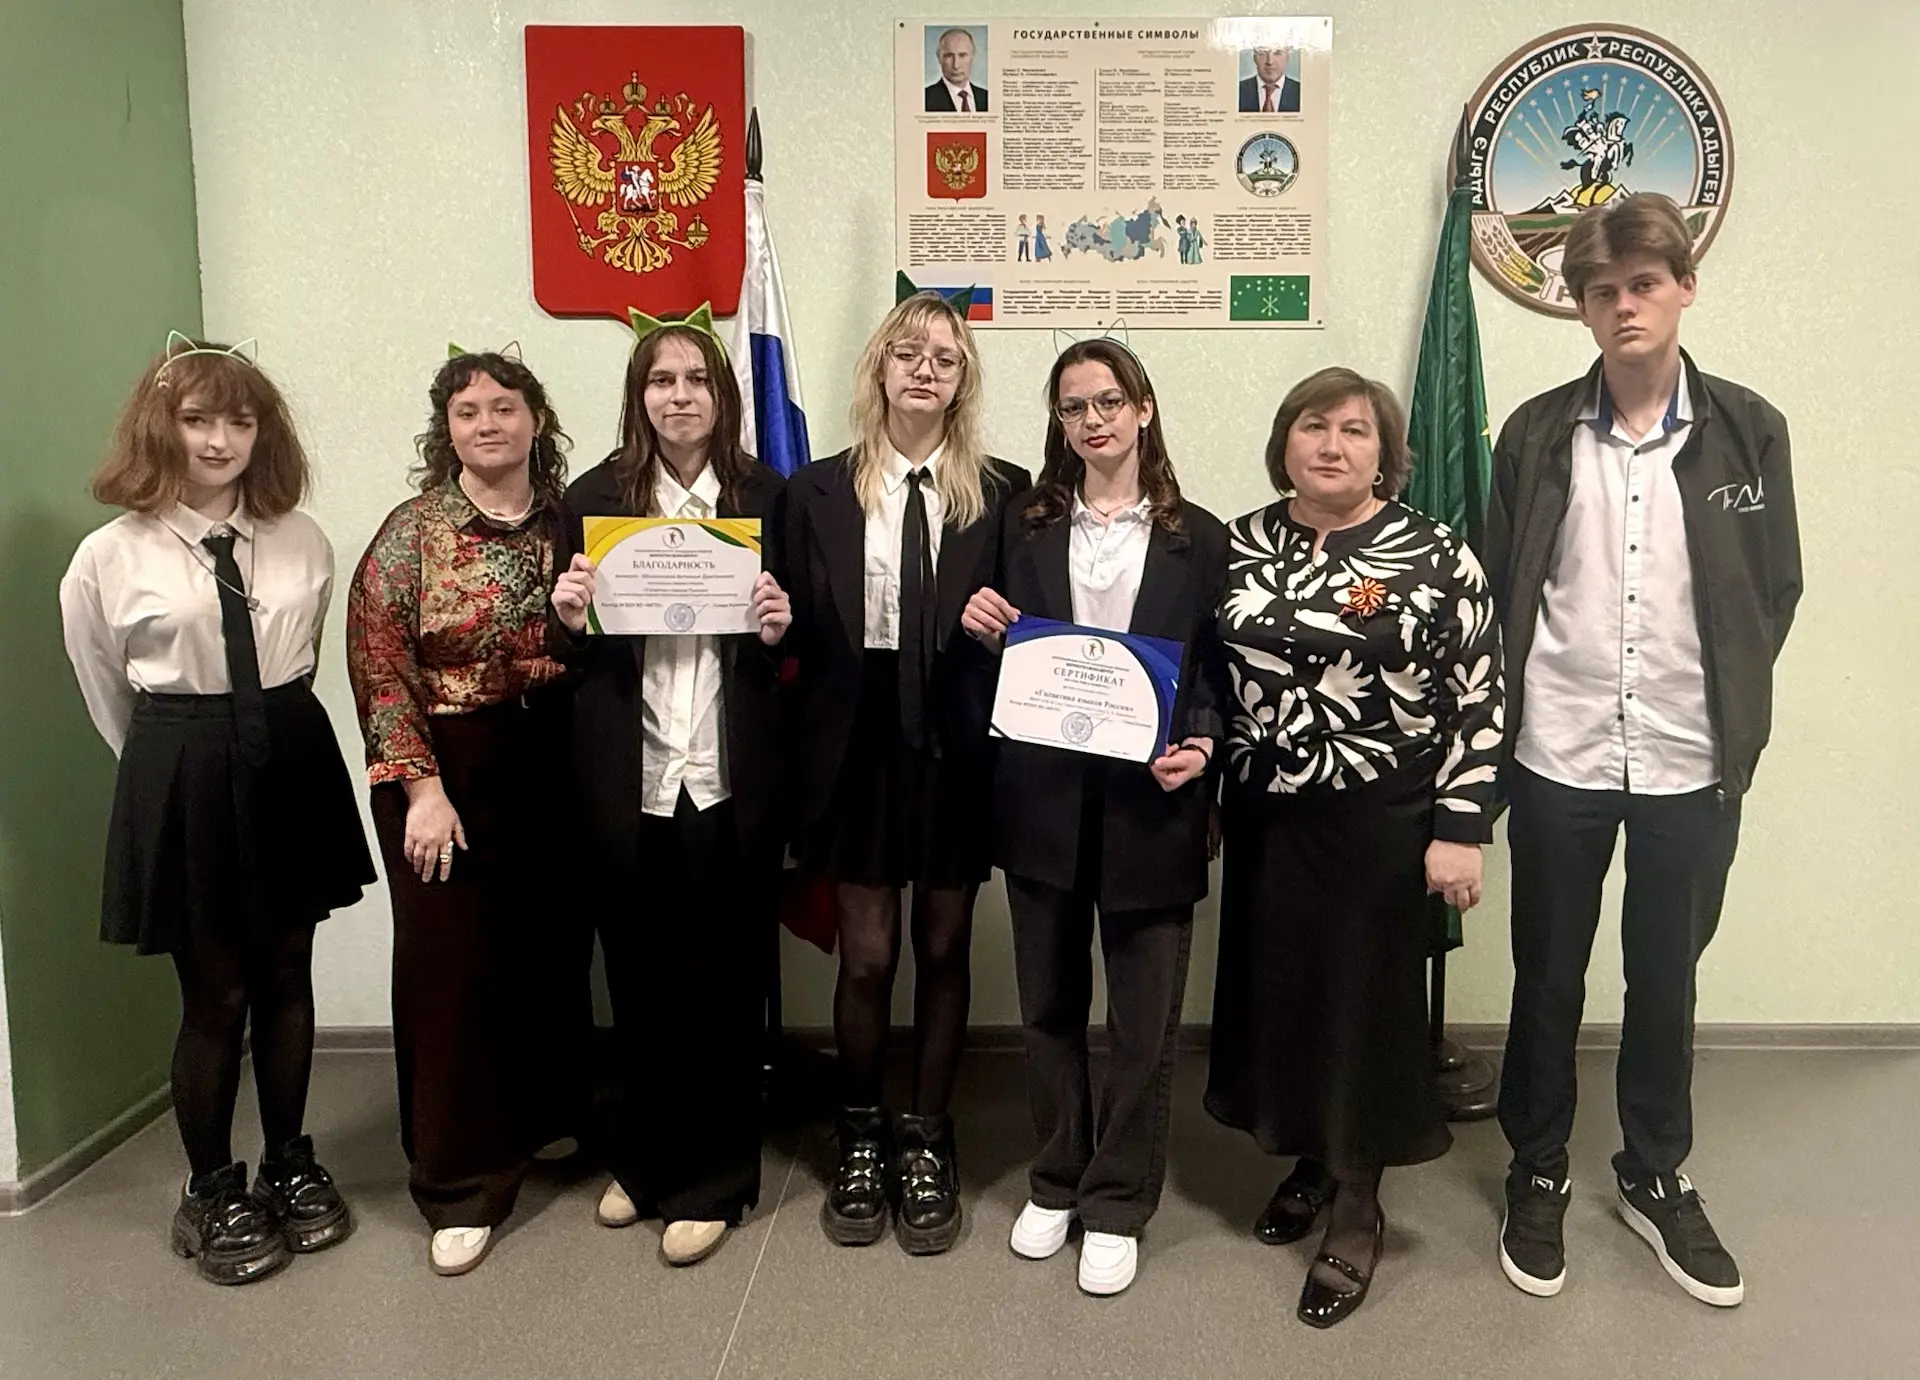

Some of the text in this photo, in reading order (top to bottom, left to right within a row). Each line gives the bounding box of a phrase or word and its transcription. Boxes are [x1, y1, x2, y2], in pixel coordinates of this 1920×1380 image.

[1013, 29, 1199, 40] ГОСУДАРСТВЕННЫЕ СИМВОЛЫ
[1469, 43, 1580, 205] АДЫГЭ РЕСПУБЛИК
[1608, 41, 1720, 203] РЕСПУБЛИКА АДЫГЕЯ
[632, 560, 716, 570] БЛАГОДАРНОСТЬ
[1053, 667, 1126, 687] СЕРТИФИКАТ
